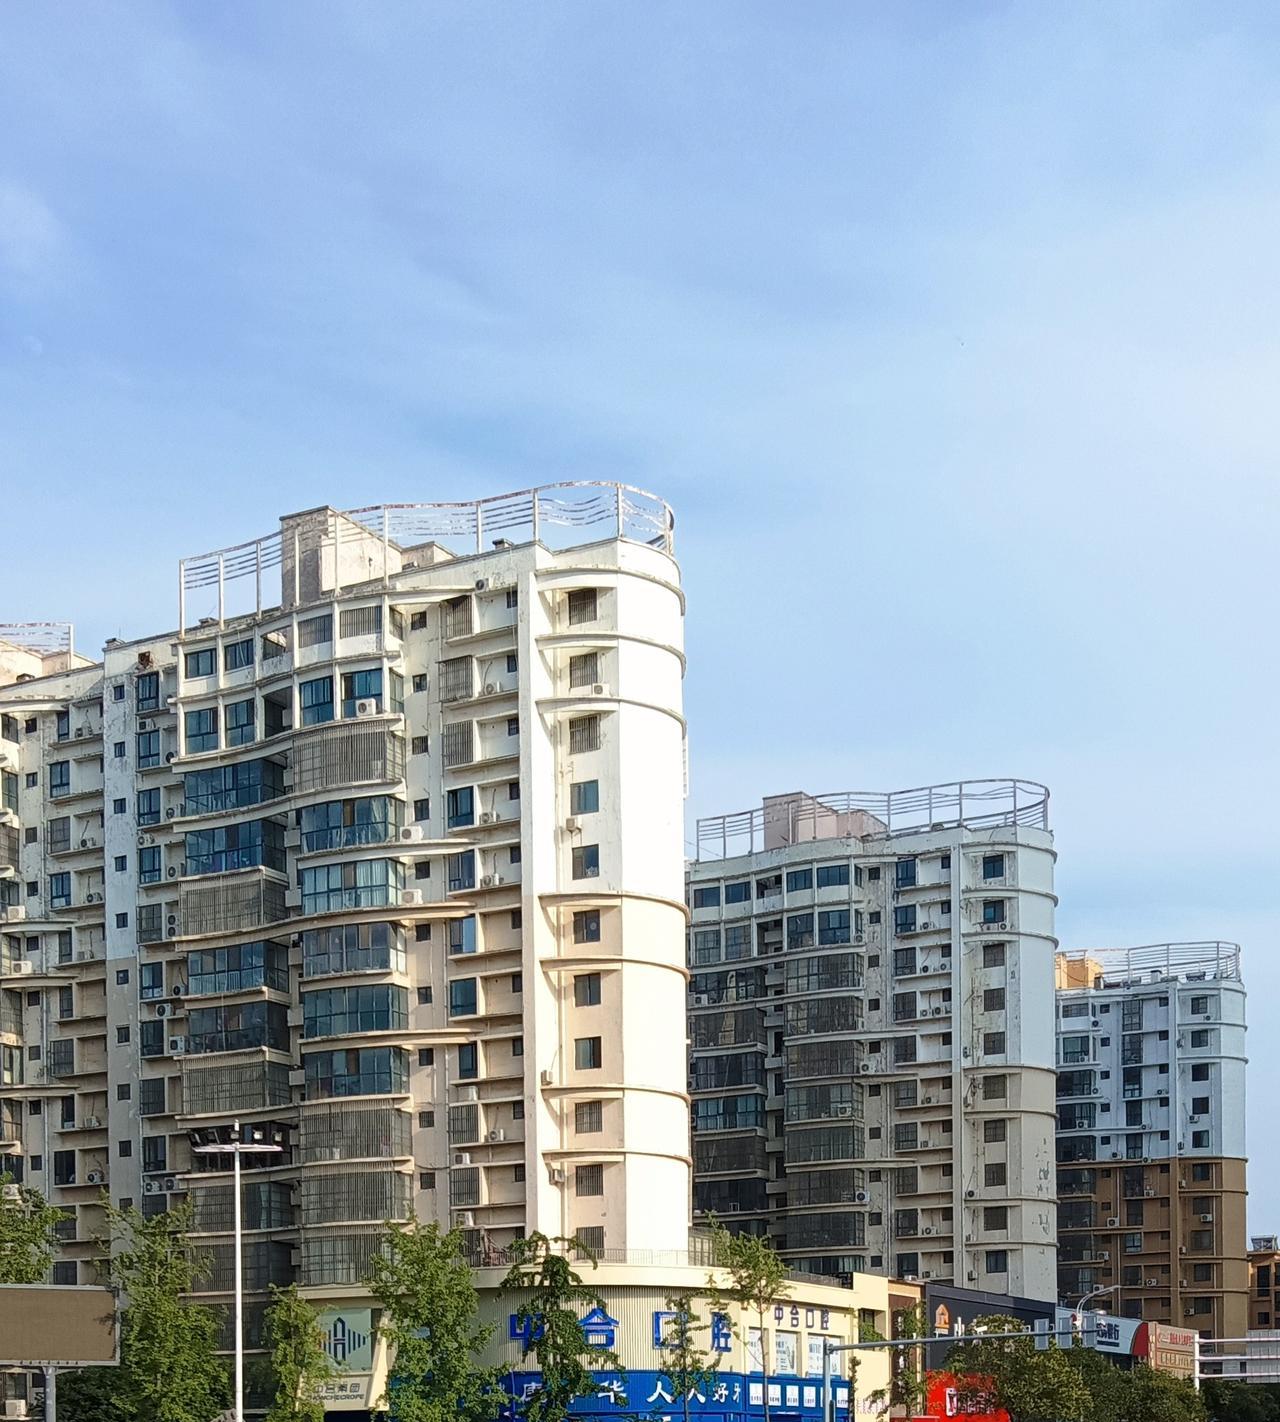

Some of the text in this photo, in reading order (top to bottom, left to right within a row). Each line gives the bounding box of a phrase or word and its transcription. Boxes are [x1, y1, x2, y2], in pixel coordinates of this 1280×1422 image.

[509, 1307, 732, 1352] 中合口腔
[774, 1302, 830, 1330] 中合口腔
